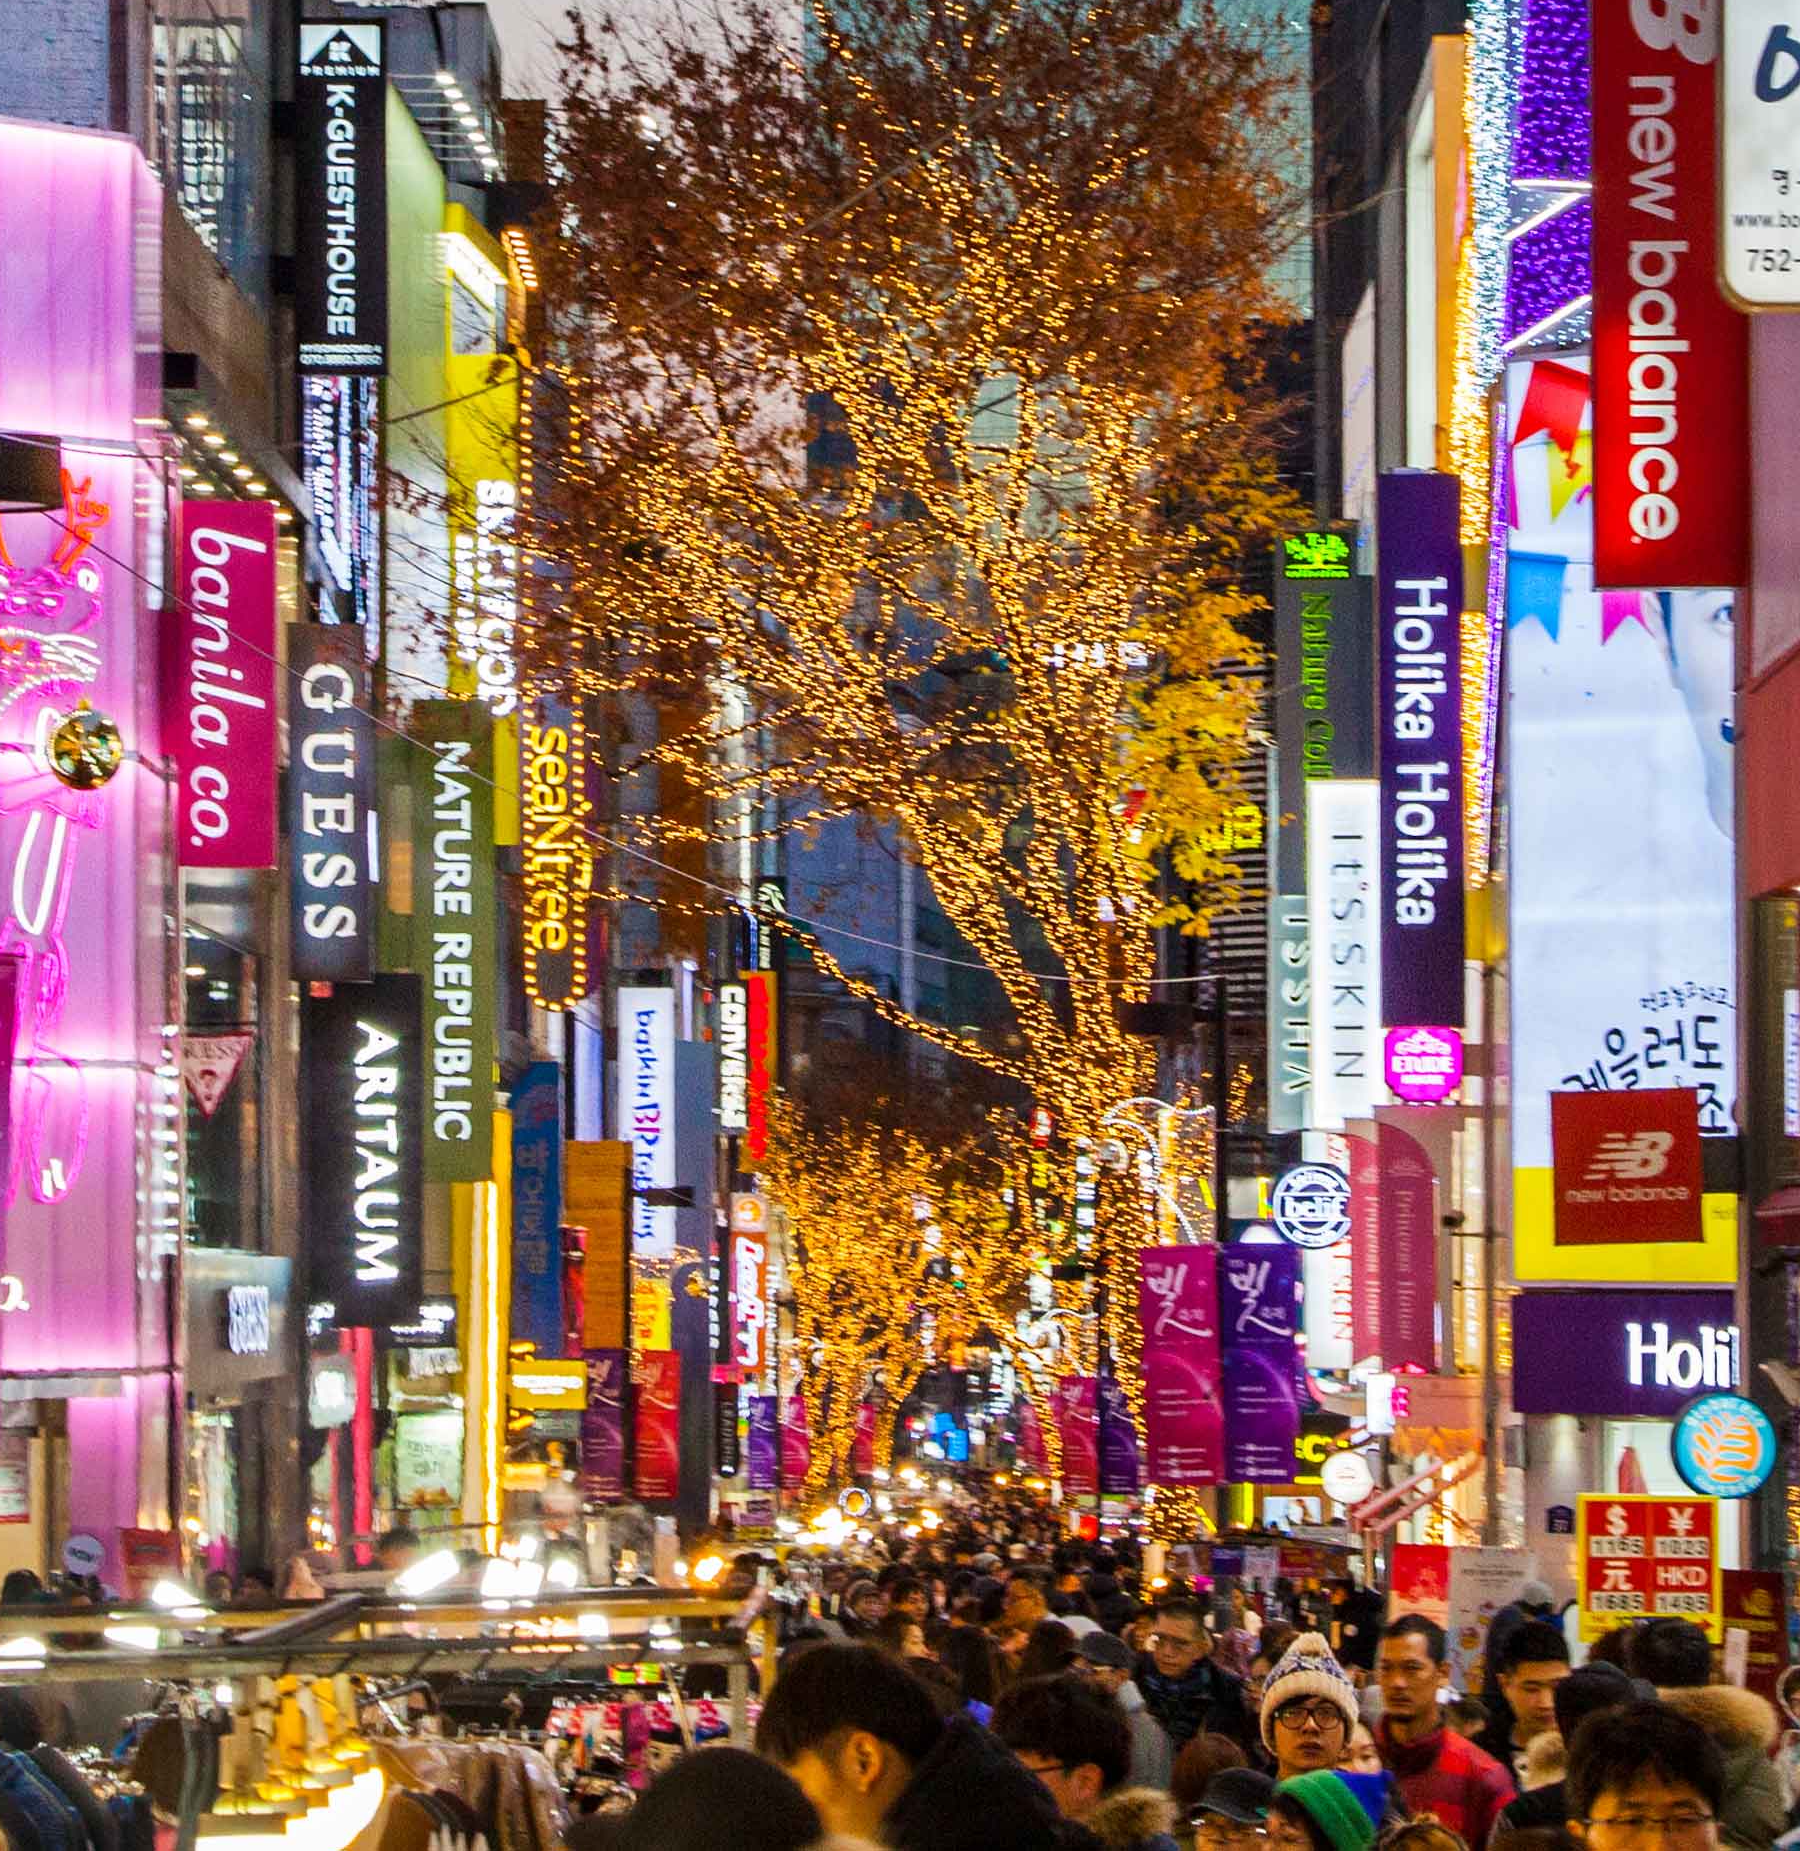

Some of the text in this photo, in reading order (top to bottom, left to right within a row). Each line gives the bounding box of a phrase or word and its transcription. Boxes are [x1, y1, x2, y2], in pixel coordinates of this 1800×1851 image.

[325, 84, 356, 337] K-GUESTHOUSE
[1628, 74, 1688, 544] new balance
[190, 526, 267, 848] banila co.
[302, 662, 358, 941] GUESS
[1394, 576, 1450, 926] Holika Holika
[432, 740, 474, 1142] NATURE REPUBLIC
[1332, 943, 1365, 1078] SKIN
[353, 1019, 400, 1282] ARITAUM
[1608, 1186, 1689, 1203] balance
[1656, 1566, 1707, 1587] HKD
